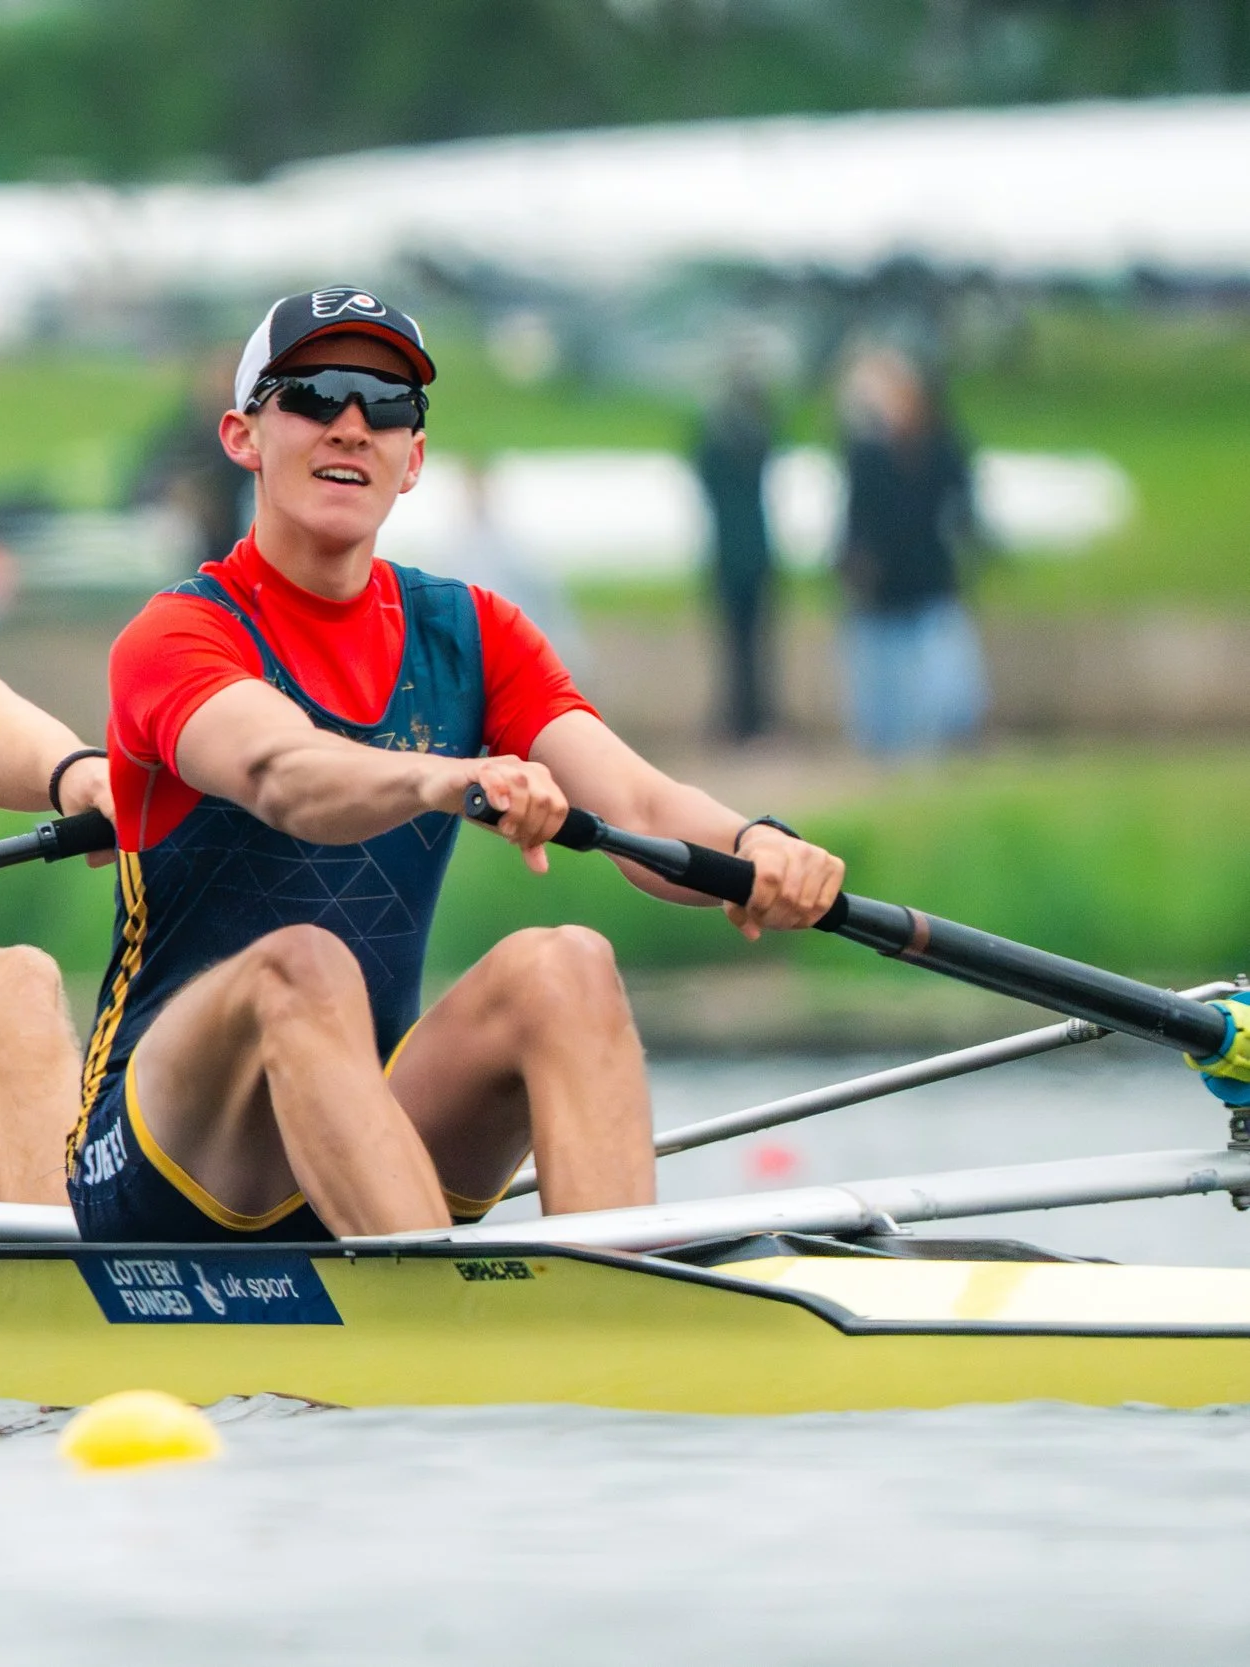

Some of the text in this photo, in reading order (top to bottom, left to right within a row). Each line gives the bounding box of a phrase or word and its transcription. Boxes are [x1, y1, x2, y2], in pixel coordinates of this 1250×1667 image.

[103, 1260, 184, 1286] LOTTERY
[221, 1273, 300, 1305] uk sport
[119, 1290, 193, 1315] FUNDED
